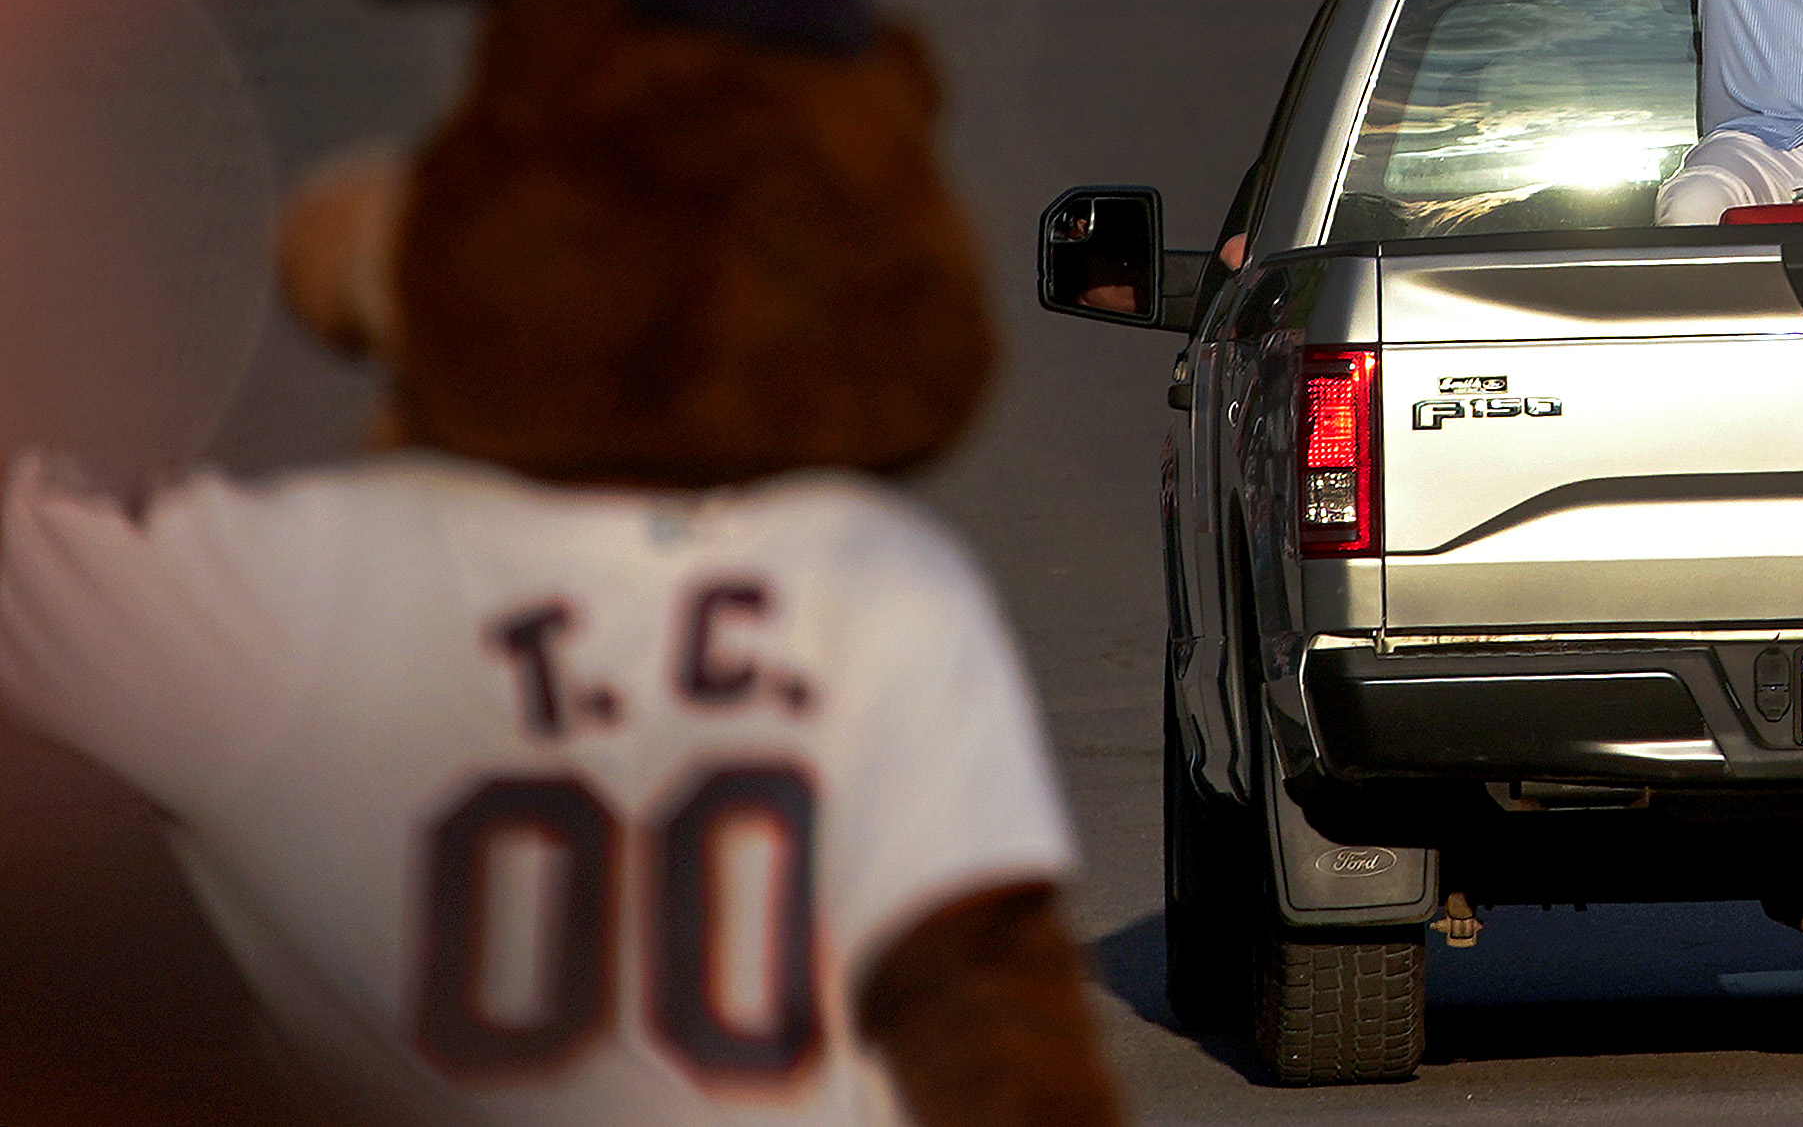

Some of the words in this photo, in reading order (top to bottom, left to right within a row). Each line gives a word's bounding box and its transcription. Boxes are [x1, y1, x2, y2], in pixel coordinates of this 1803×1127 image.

[1412, 397, 1563, 431] F150
[1333, 850, 1380, 872] Ford
[408, 754, 830, 1102] 00
